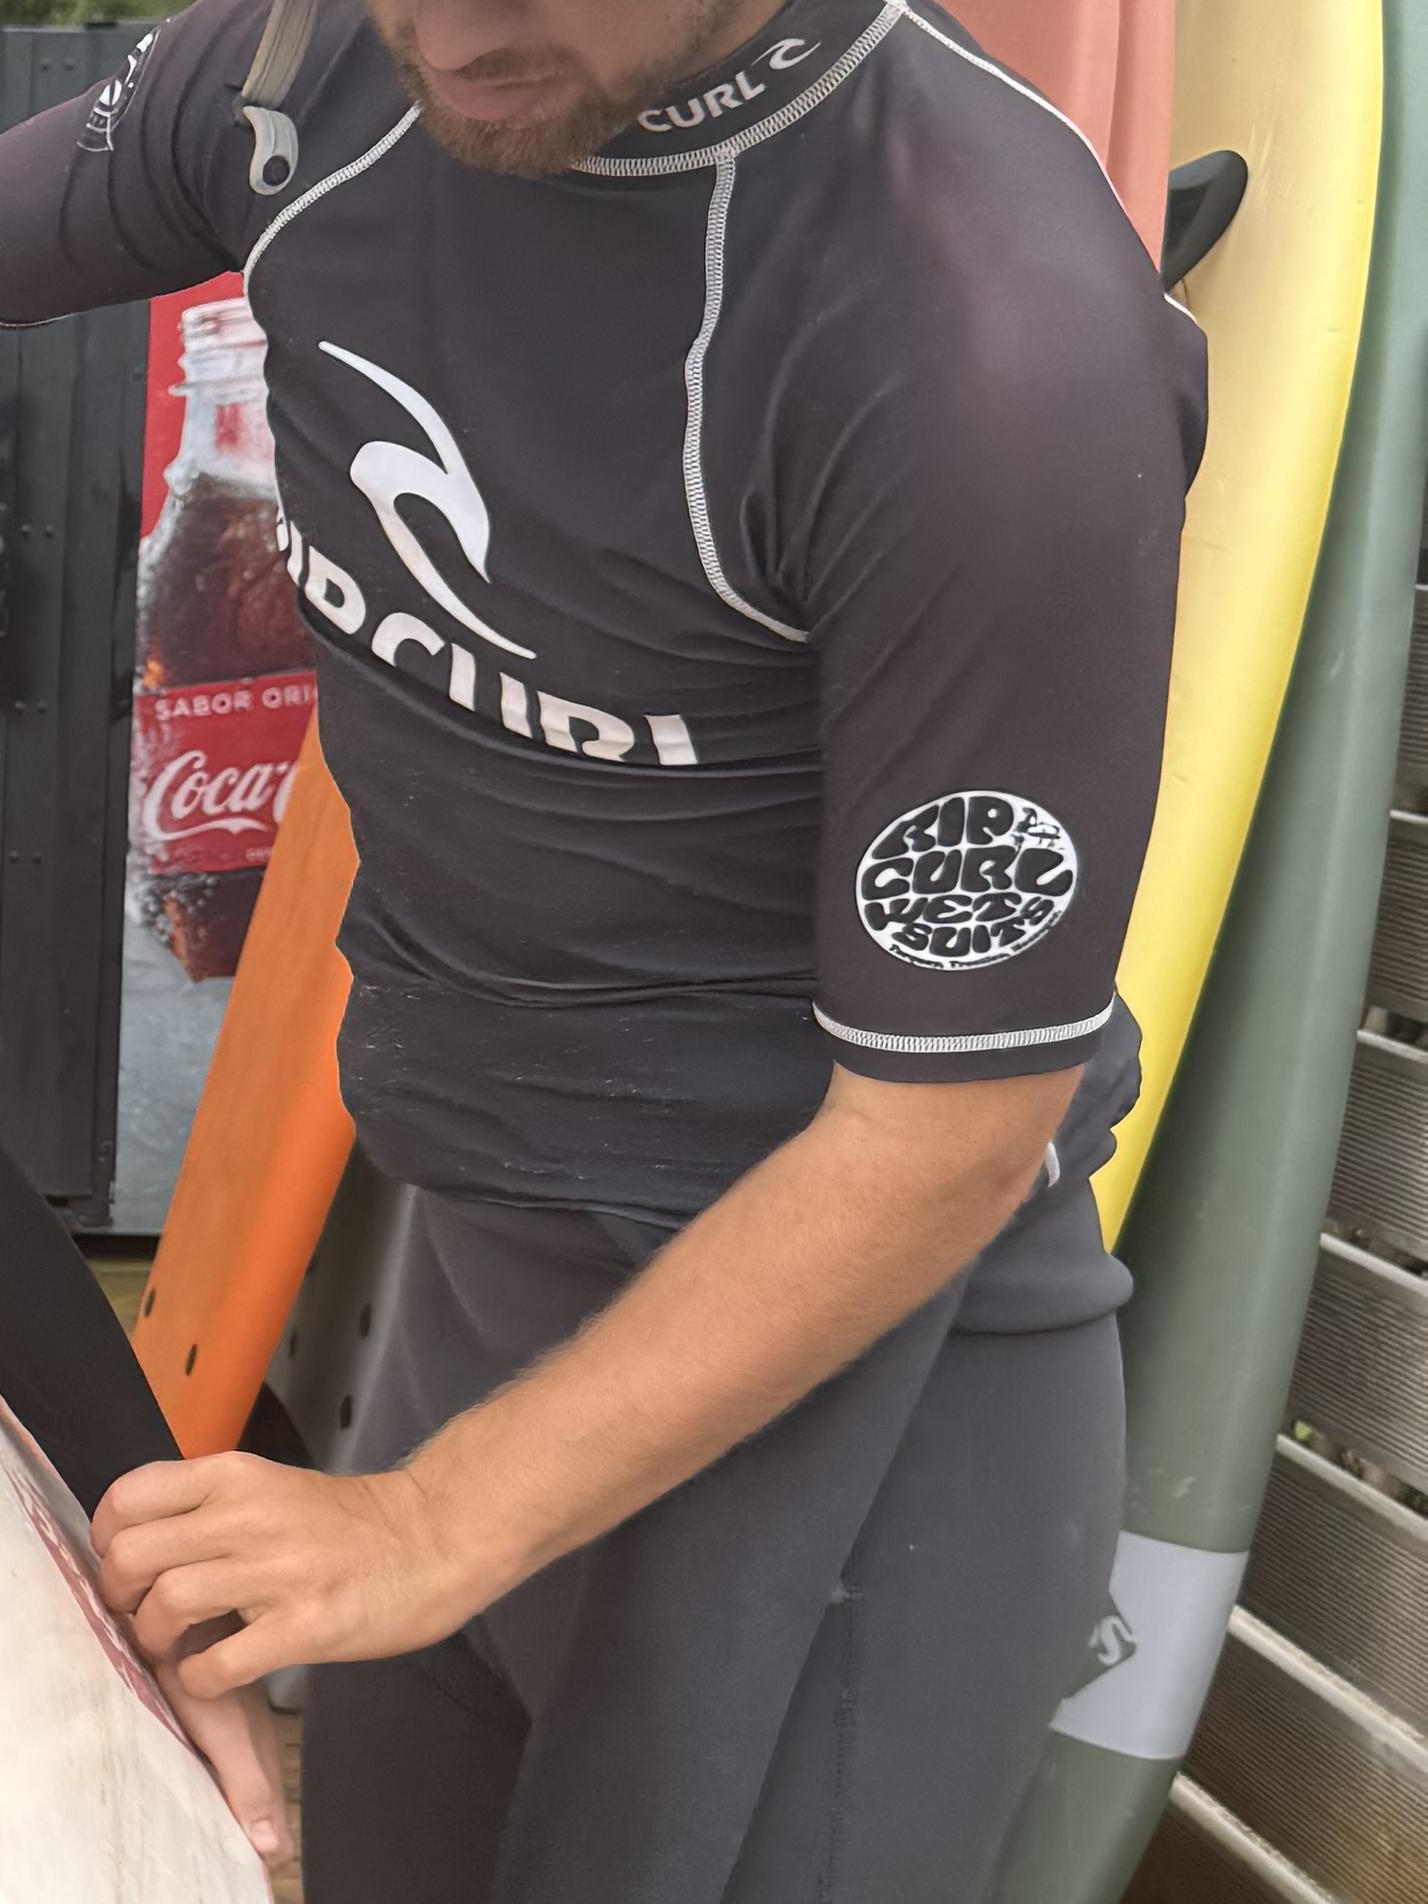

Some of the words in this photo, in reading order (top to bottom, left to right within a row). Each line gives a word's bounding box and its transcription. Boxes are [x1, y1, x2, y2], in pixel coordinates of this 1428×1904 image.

[637, 70, 766, 132] CURL
[155, 690, 253, 721] SABOR
[871, 796, 1014, 860] RIP
[861, 844, 1074, 901] CURL
